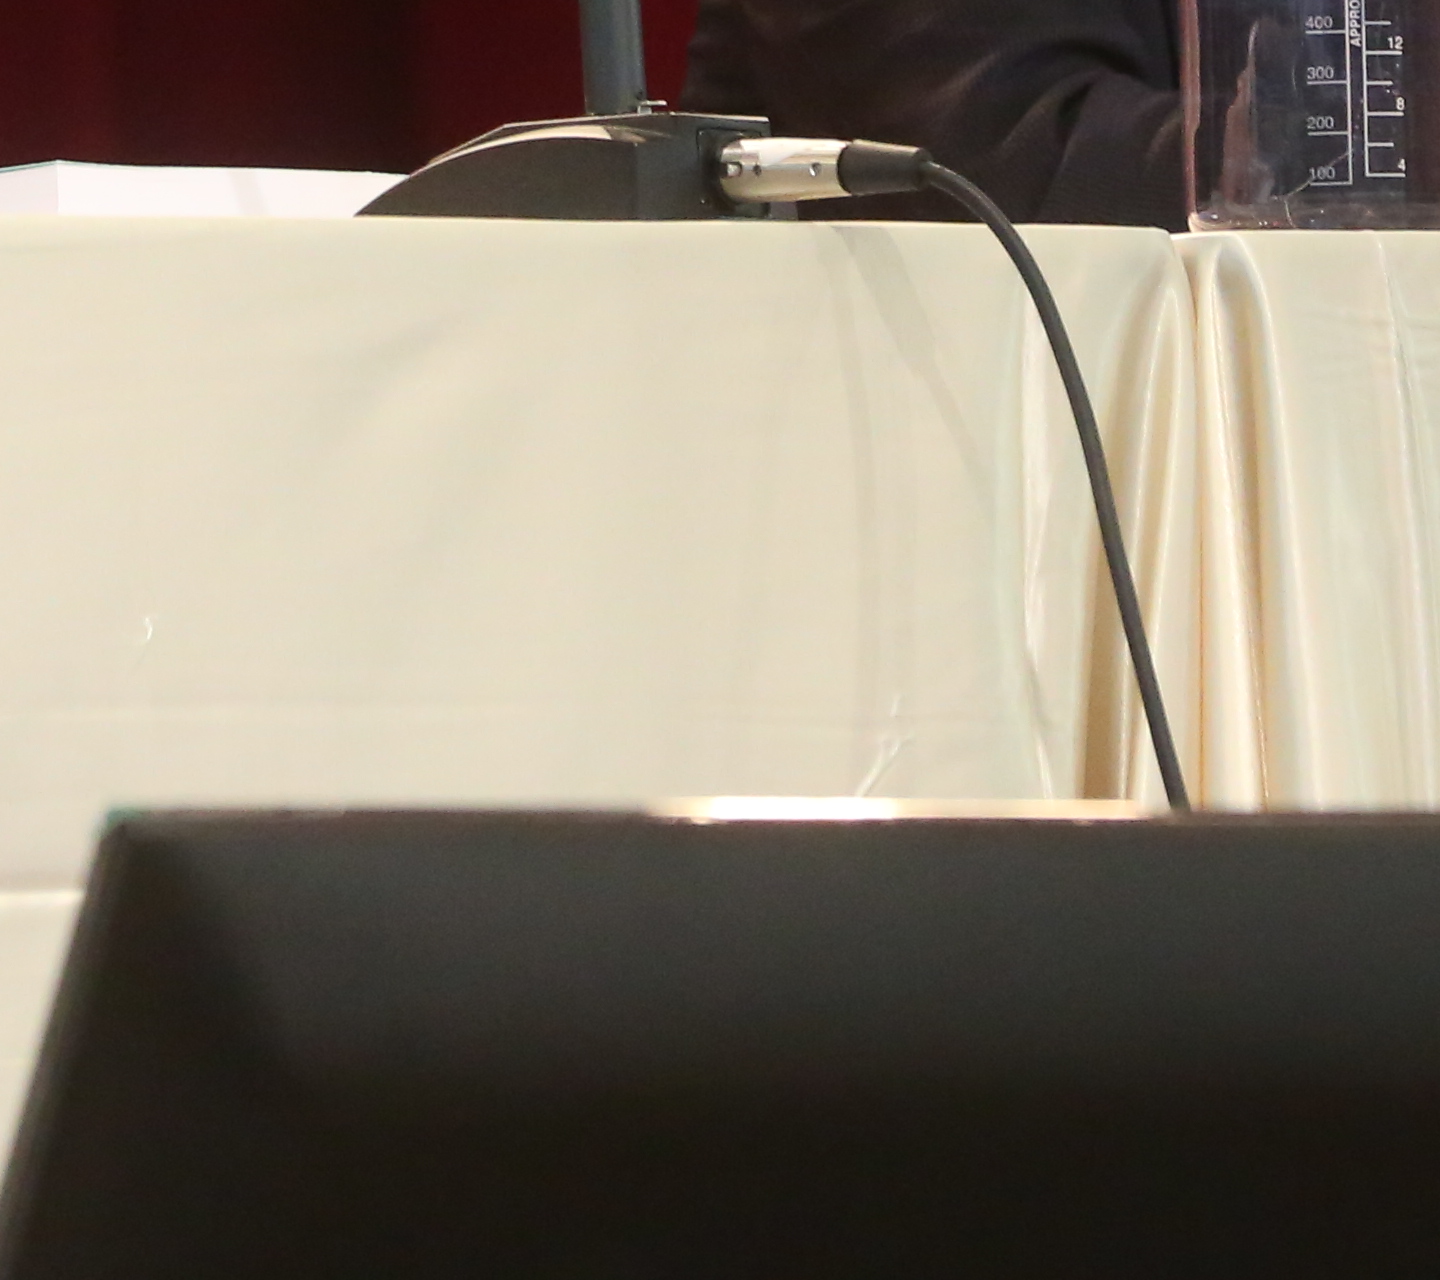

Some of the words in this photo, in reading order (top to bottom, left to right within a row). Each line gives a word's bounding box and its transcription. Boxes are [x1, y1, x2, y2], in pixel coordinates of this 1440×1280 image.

[1305, 15, 1333, 29] 400
[1387, 35, 1404, 50] 12
[1307, 66, 1335, 80] 300
[1396, 96, 1405, 111] 8
[1307, 116, 1335, 130] 200
[1397, 158, 1406, 171] 4
[1309, 166, 1336, 179] 100
